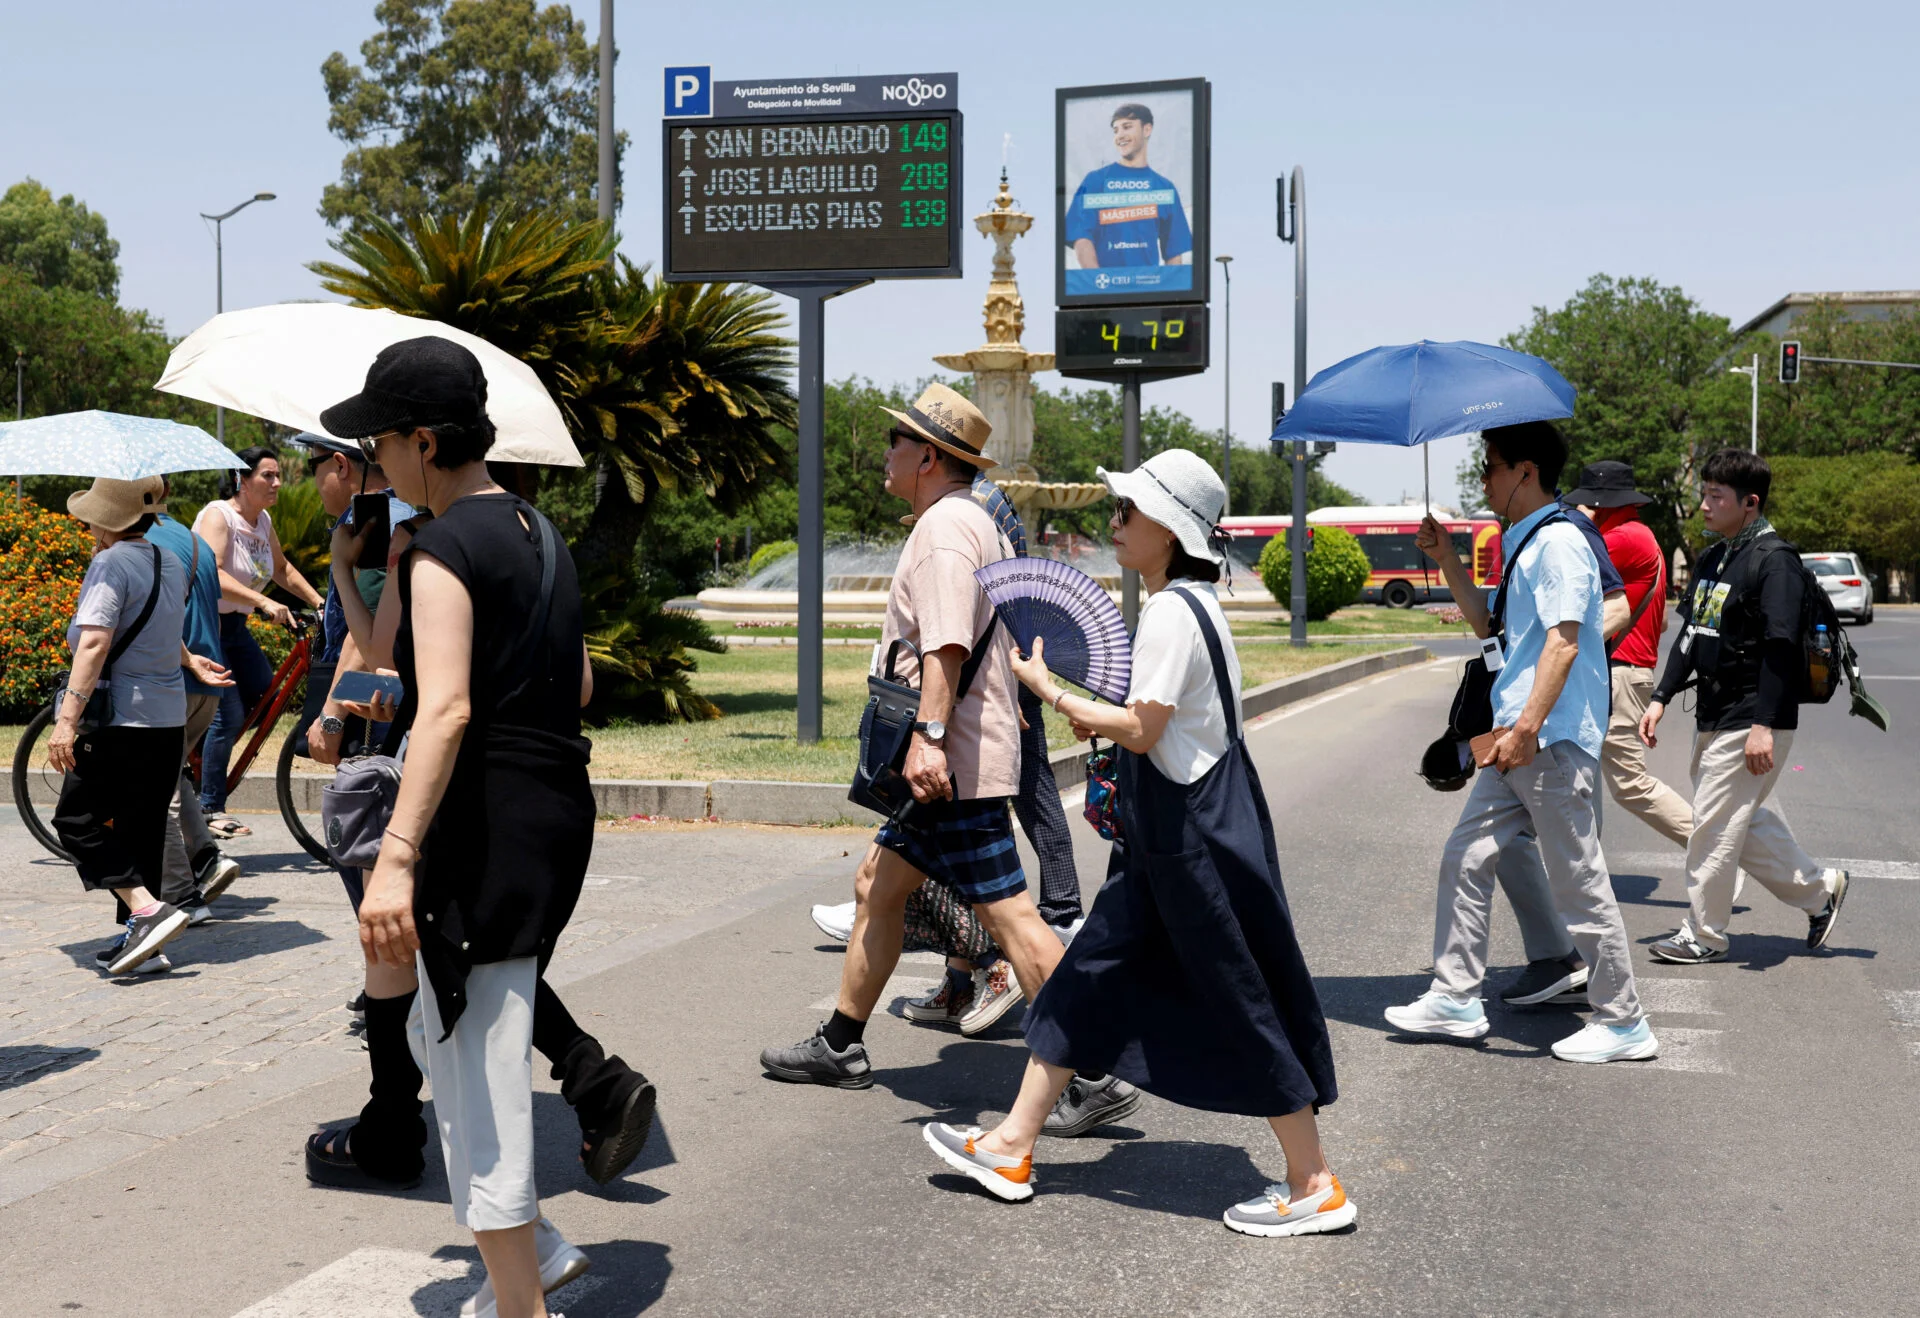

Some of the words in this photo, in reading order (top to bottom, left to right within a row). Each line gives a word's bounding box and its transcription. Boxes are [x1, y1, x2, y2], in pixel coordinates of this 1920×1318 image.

[674, 74, 699, 108] P
[733, 84, 804, 98] Ayuntamiento
[806, 83, 819, 93] de
[822, 82, 856, 94] Sevilla
[747, 99, 792, 109] Delegación
[793, 99, 803, 107] de
[804, 97, 842, 108] Movilidad
[704, 128, 752, 158] SAN
[761, 124, 890, 157] BERNARDO
[898, 122, 947, 153] 149
[703, 167, 763, 196] JOSE
[768, 164, 877, 195] LAGUILLO
[900, 162, 948, 191] 208
[1107, 180, 1150, 189] GRADOS
[1128, 192, 1171, 203] GRADOS
[704, 202, 819, 232] ESCUELAS
[827, 201, 883, 229] PIAS
[900, 199, 947, 227] 139
[1102, 206, 1157, 220] MÁSTERES
[928, 412, 956, 434] EGYPT
[1366, 527, 1399, 535] SEVILLA
